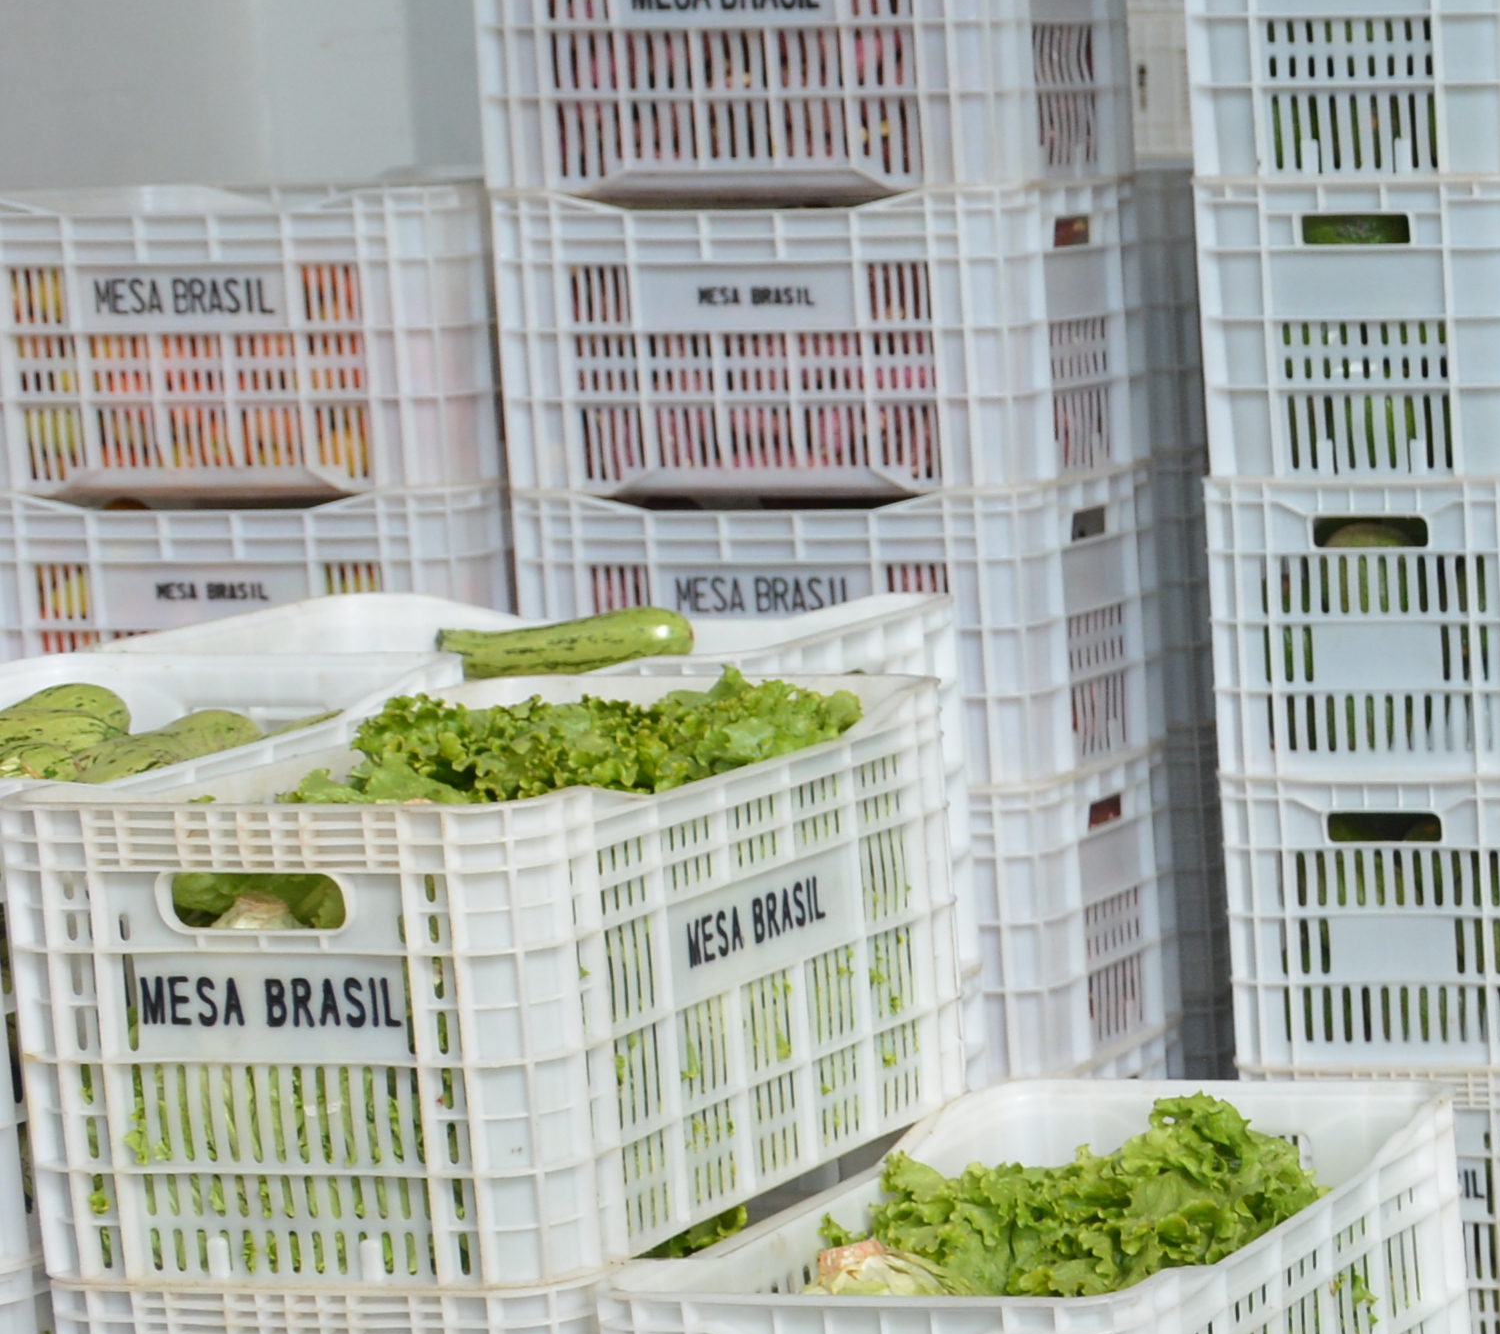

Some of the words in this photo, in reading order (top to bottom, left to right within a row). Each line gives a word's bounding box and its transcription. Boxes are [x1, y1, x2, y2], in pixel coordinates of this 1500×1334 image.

[93, 277, 164, 315] MESA
[171, 277, 275, 315] BRASIL
[698, 287, 741, 305] MESA
[750, 287, 814, 306] BRASIL
[155, 582, 198, 600] MESA
[206, 582, 268, 601] BRASIL
[675, 576, 745, 613] MESA
[686, 906, 744, 969] MESA
[751, 875, 826, 945] BRASIL
[139, 975, 245, 1027] MESA
[264, 976, 403, 1028] BRASIL
